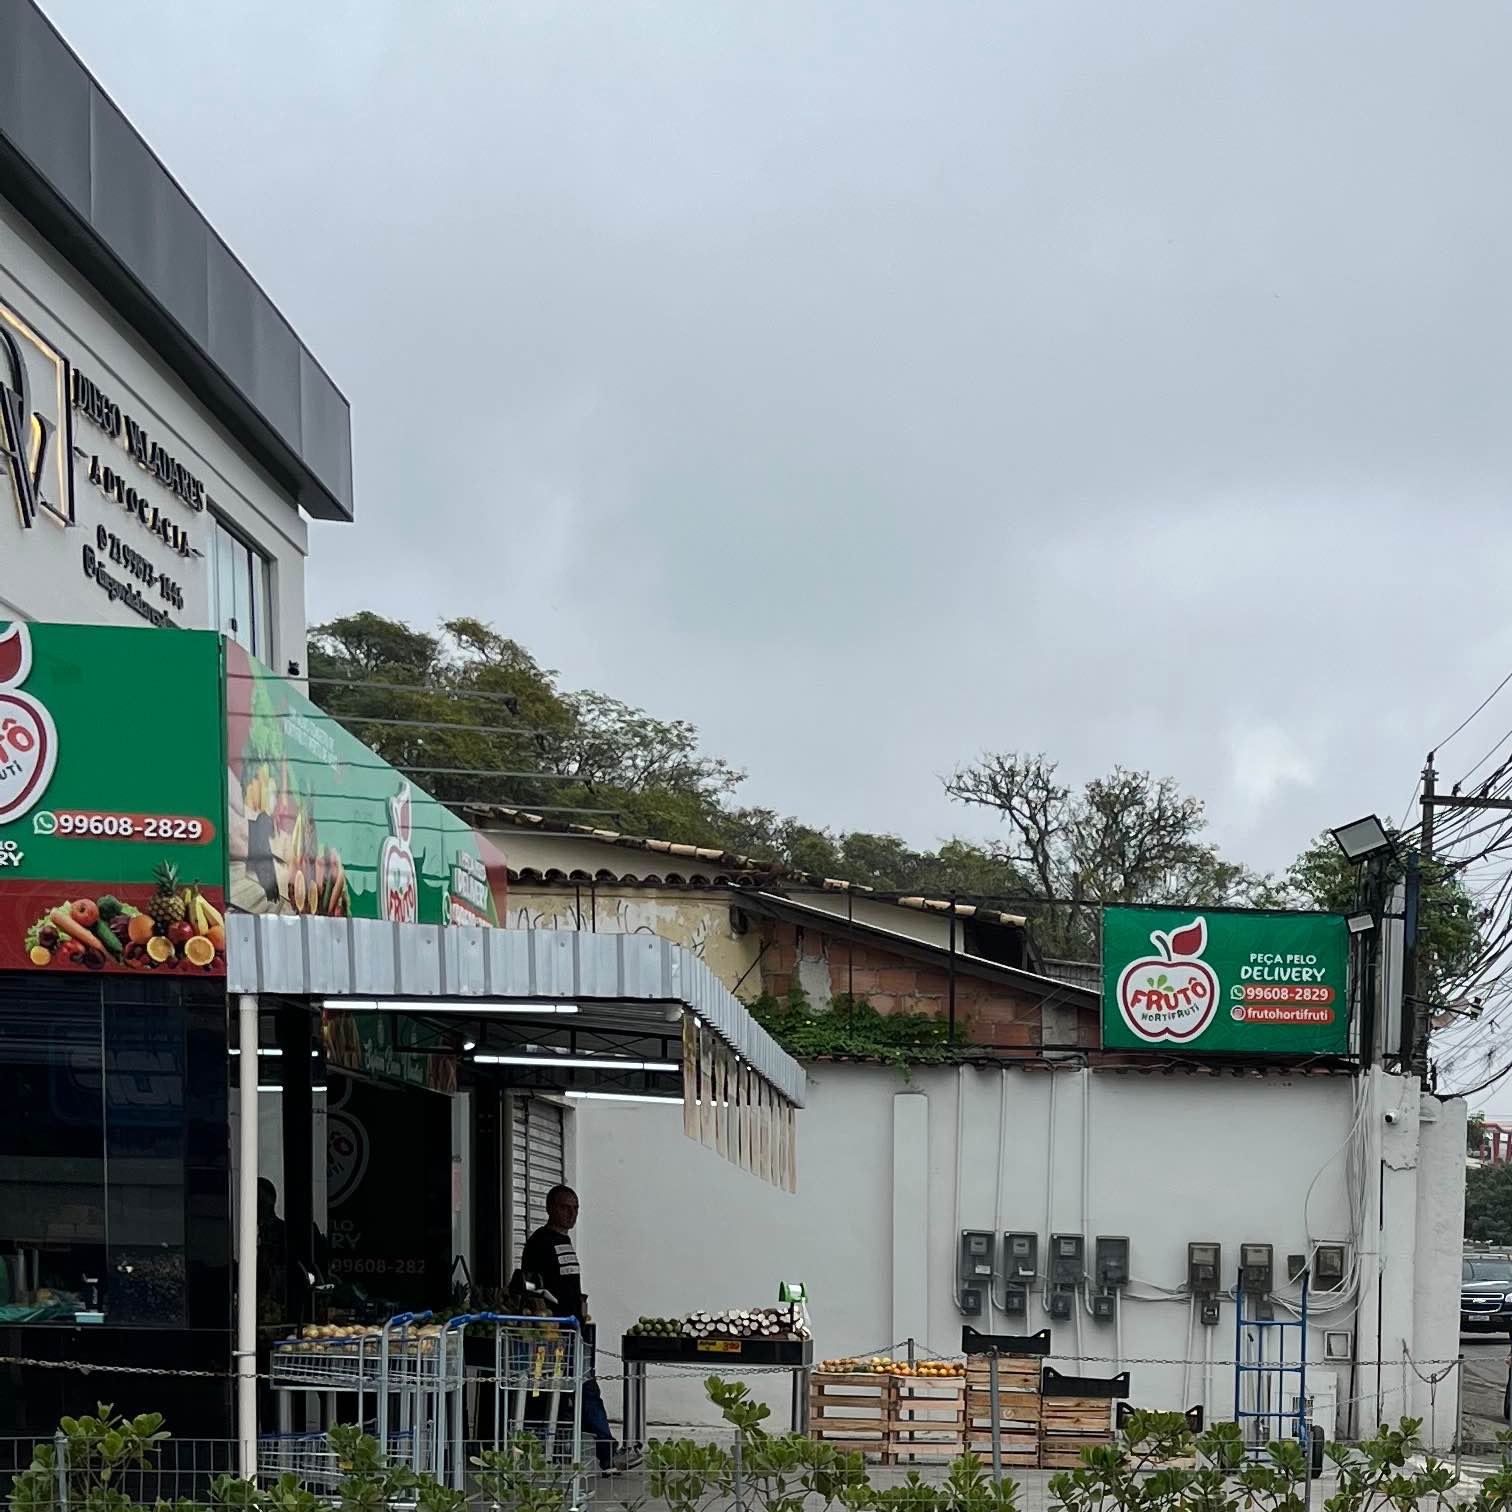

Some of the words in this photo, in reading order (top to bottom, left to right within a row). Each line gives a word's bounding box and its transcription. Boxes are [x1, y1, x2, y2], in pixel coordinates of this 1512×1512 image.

[59, 814, 203, 839] 99608-2829
[1249, 953, 1283, 965] PEÇA
[1286, 954, 1317, 965] PELO
[1241, 966, 1326, 982] DELIVERY
[1130, 976, 1207, 1012] FRUTÔ
[1246, 987, 1328, 1001] 99608-2829
[1247, 1007, 1328, 1021] frutohortifruti
